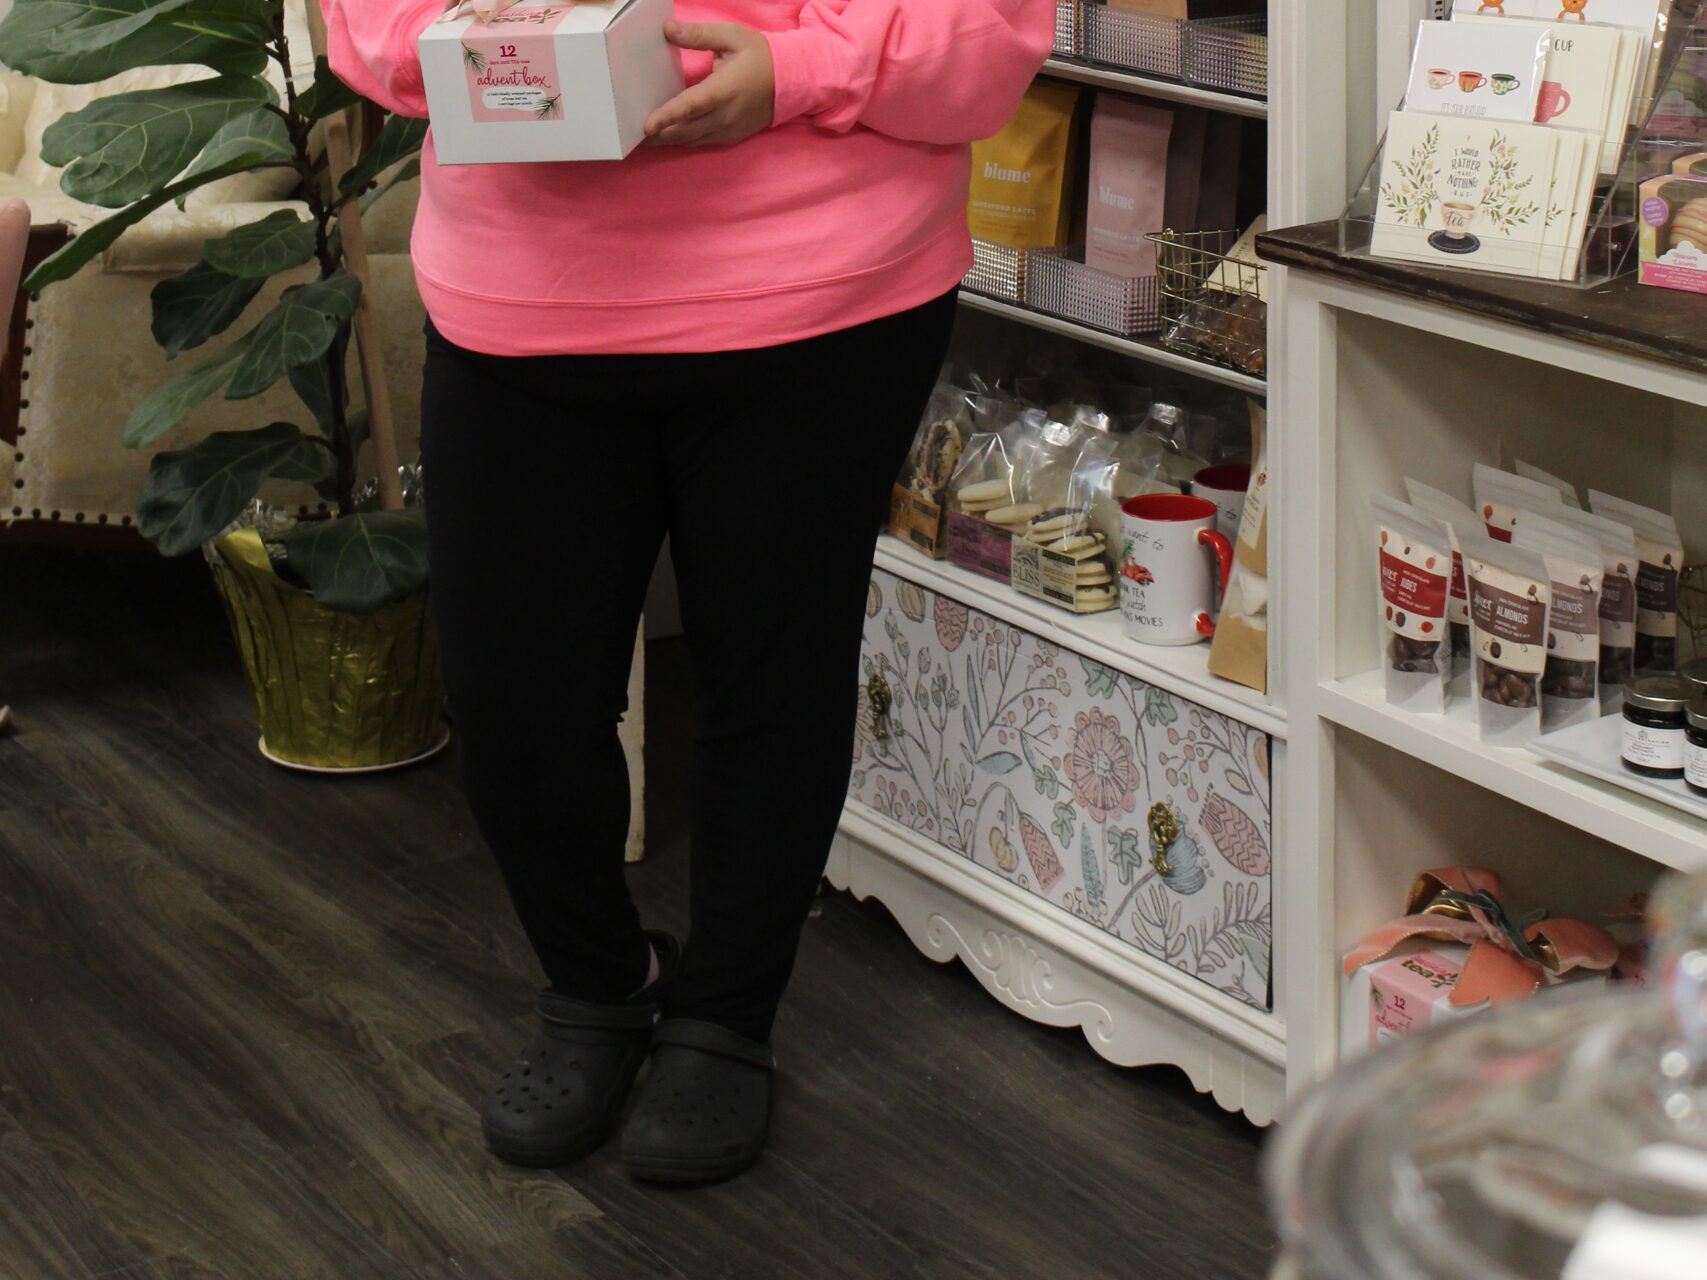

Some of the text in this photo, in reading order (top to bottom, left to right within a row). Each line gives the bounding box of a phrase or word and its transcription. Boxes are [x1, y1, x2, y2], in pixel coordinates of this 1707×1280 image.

[499, 45, 517, 58] 12
[1554, 38, 1575, 52] CUP
[477, 66, 552, 89] advent box
[1461, 148, 1479, 158] WOULD
[984, 160, 1032, 184] blume
[1451, 158, 1480, 172] RATHER
[1447, 174, 1479, 189] NOTHING
[1099, 185, 1135, 210] blume
[1012, 563, 1040, 585] BLISS
[1132, 587, 1146, 599] TEA
[1552, 596, 1584, 614] LMONDS
[1134, 614, 1164, 628] MOVIES
[1496, 605, 1529, 625] ALMONDS
[1400, 960, 1435, 979] tea
[1394, 994, 1406, 1010] 12
